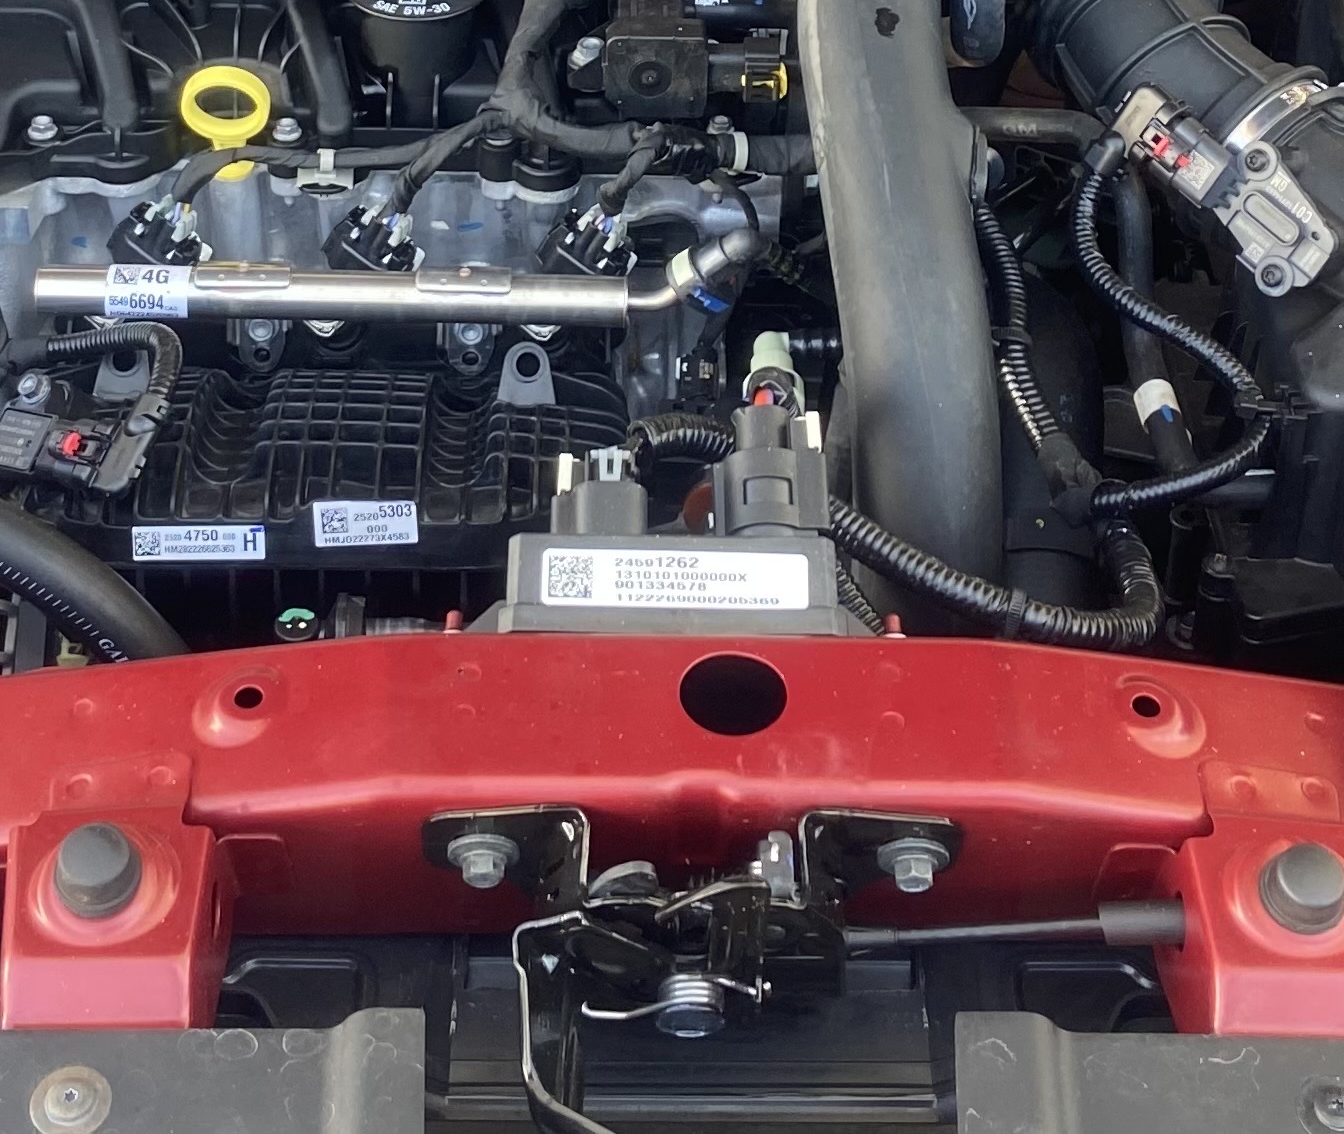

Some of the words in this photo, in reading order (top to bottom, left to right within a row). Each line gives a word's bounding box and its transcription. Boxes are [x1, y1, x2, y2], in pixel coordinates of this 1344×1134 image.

[373, 0, 399, 14] SAE
[403, 2, 451, 16] 5W-30
[142, 269, 170, 284] 4G
[367, 525, 387, 533] 000
[244, 533, 256, 551] H
